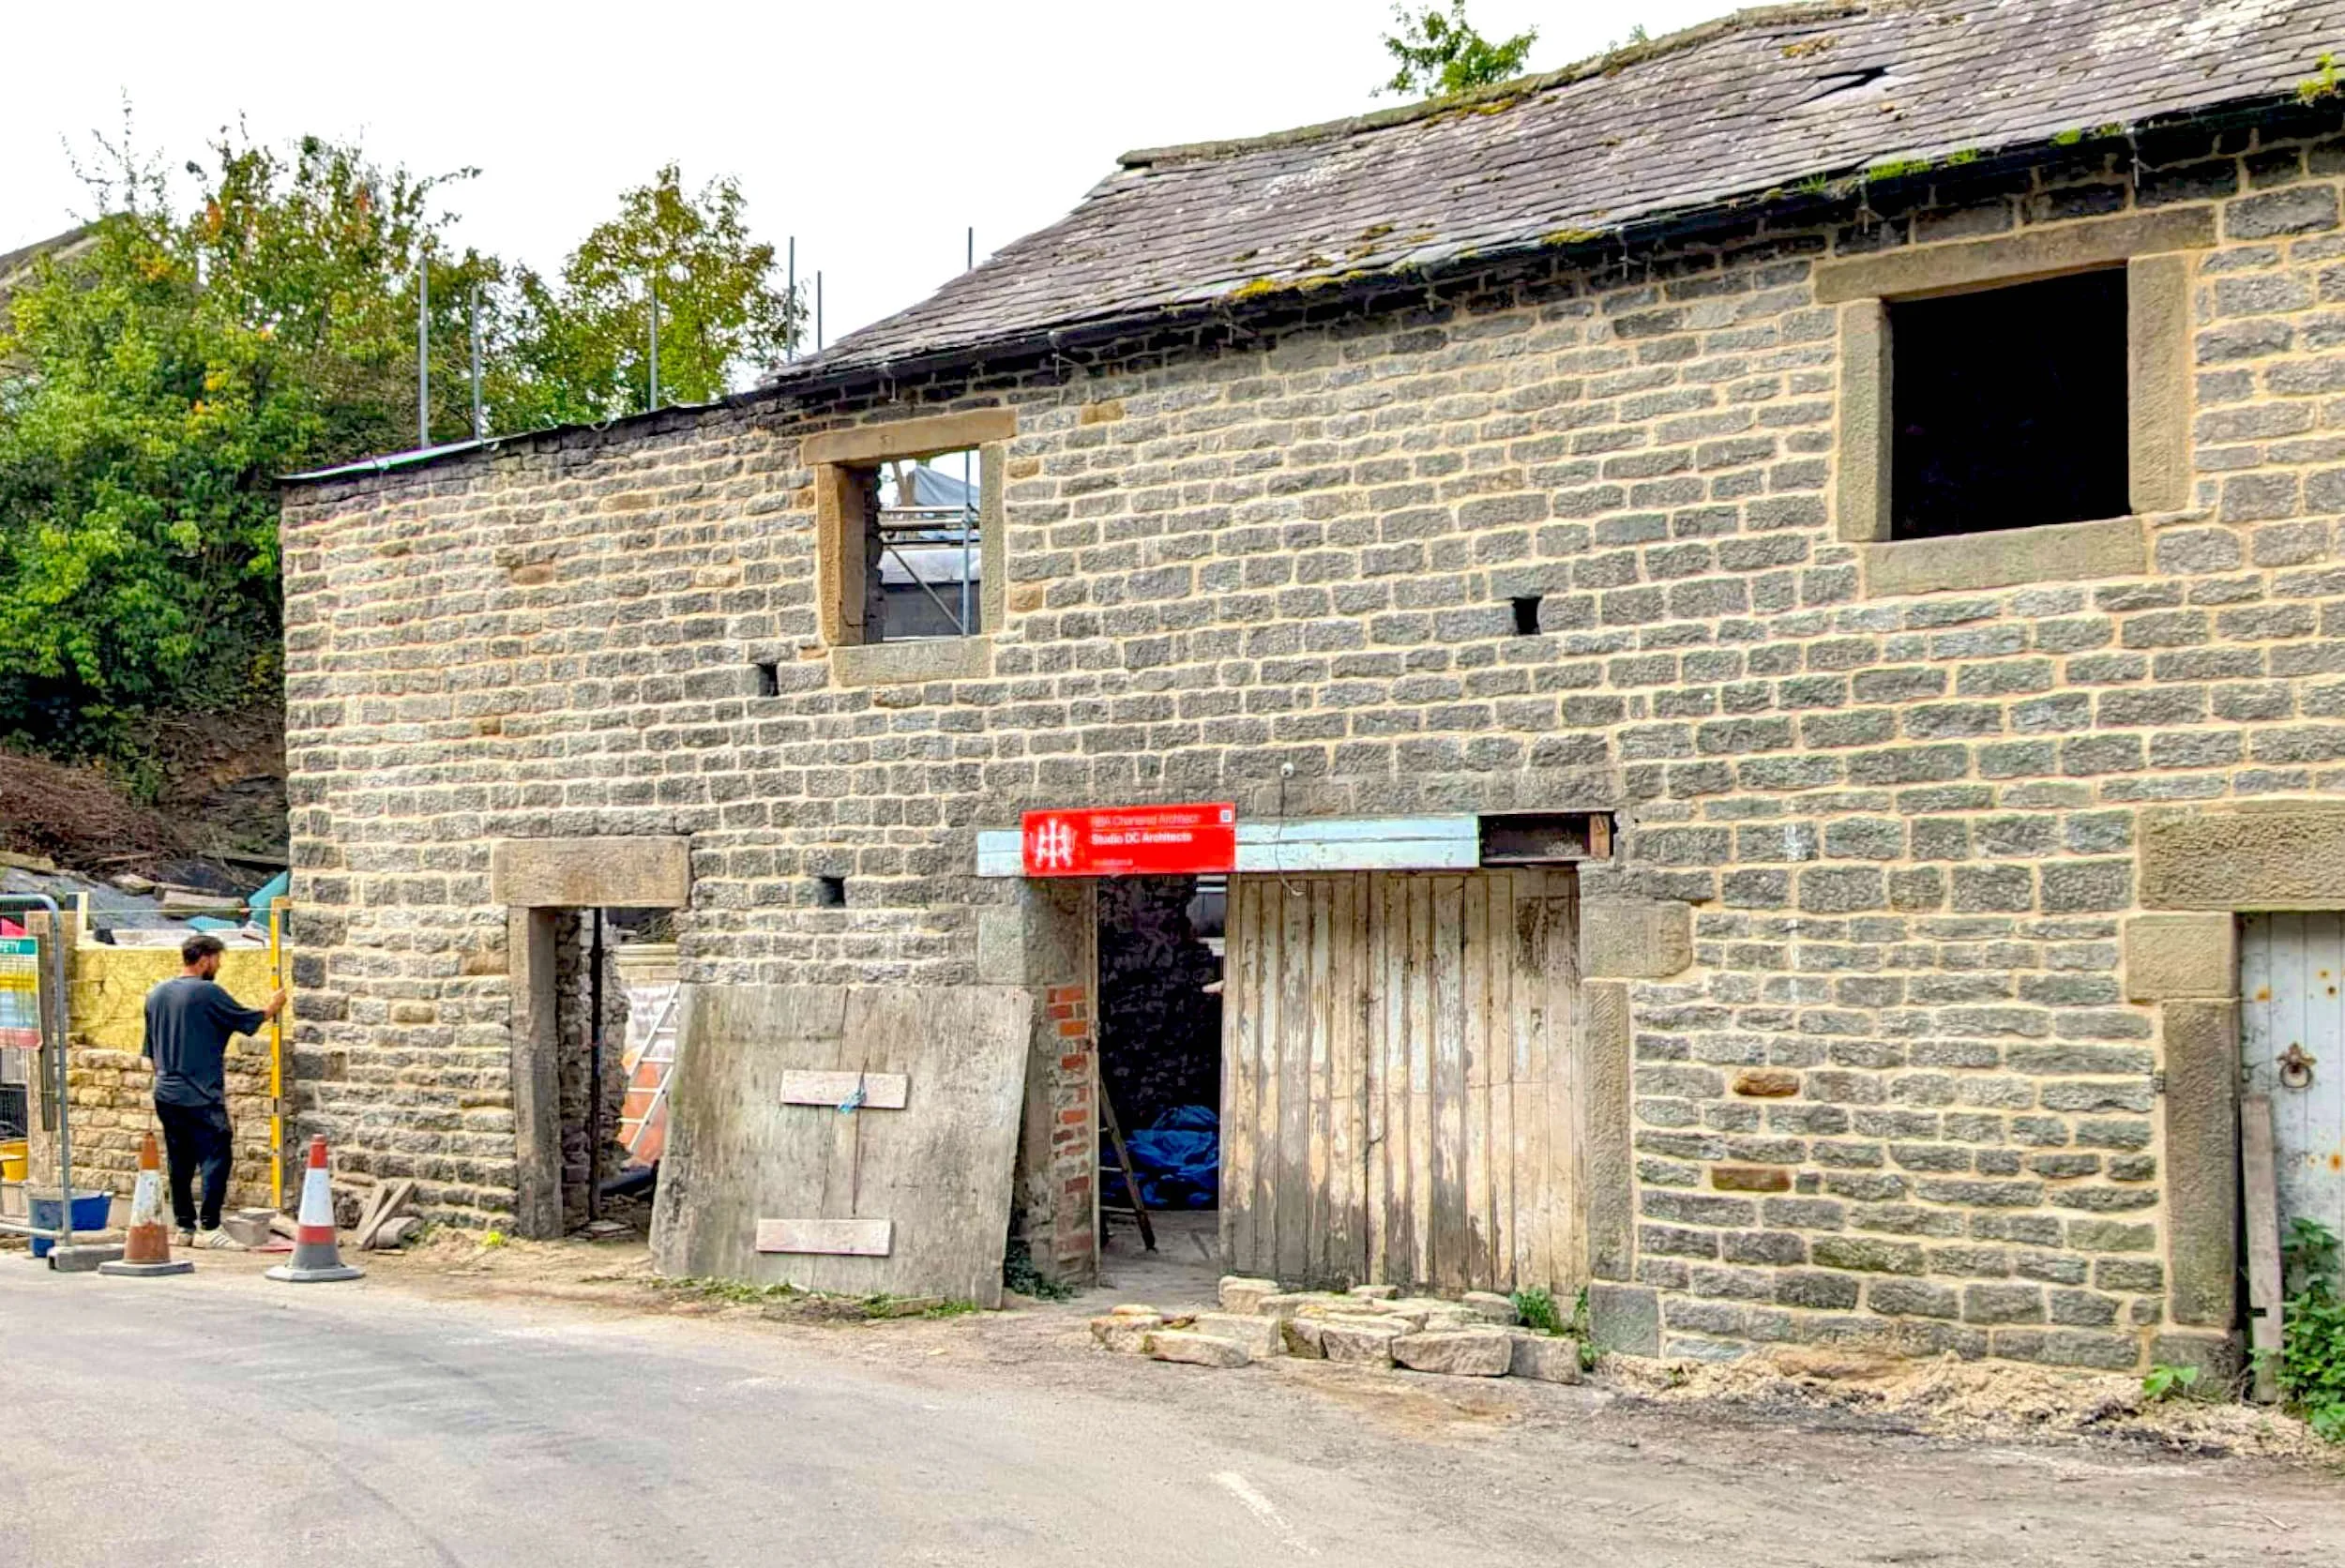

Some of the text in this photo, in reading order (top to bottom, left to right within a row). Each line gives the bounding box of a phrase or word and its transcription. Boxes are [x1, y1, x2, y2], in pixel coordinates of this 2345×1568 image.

[1091, 832, 1193, 845] Studio DC Architects
